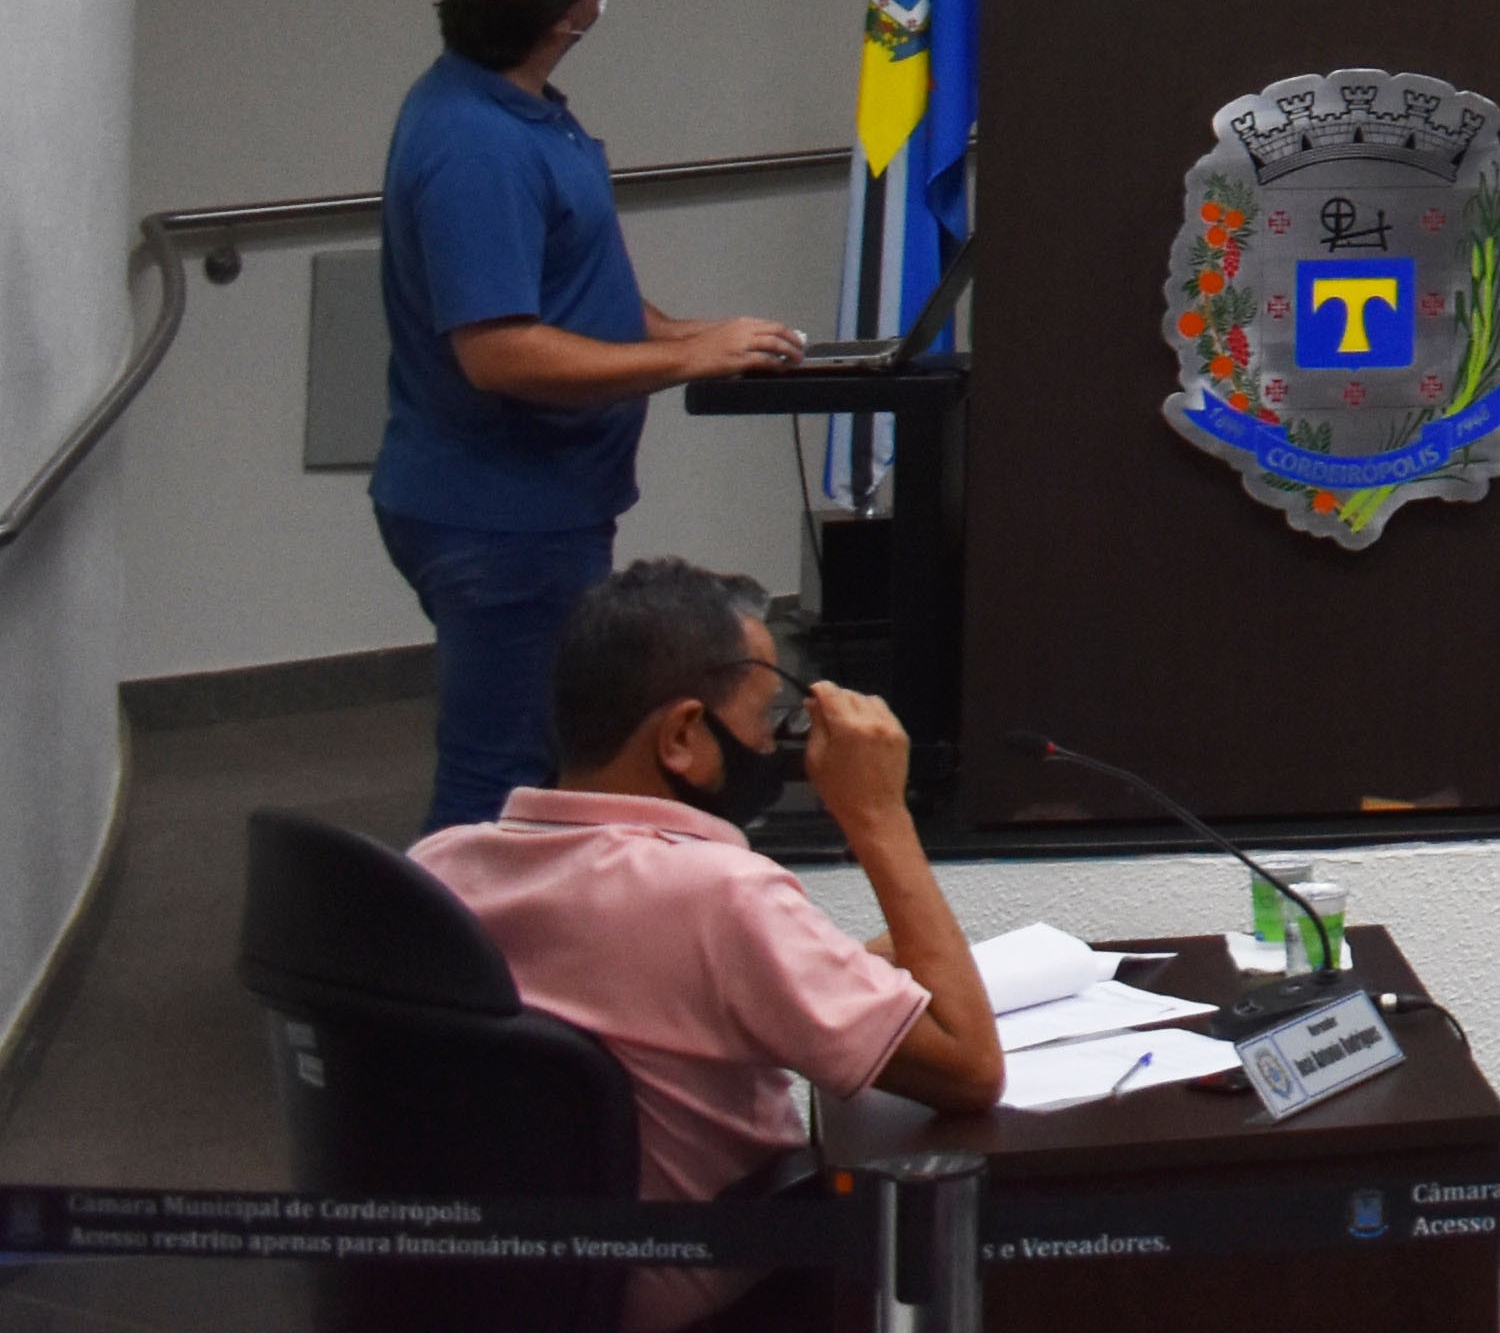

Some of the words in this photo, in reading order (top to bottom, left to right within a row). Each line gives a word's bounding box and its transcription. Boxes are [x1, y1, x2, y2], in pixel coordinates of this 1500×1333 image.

[1266, 444, 1440, 484] CORDEIRÓPOLIS
[163, 1196, 279, 1222] Municipal
[285, 1199, 314, 1219] de
[1412, 1214, 1495, 1236] Acesso
[153, 1230, 242, 1250] restrito
[249, 1233, 332, 1257] apenas
[337, 1235, 390, 1258] para
[398, 1234, 547, 1257] funcionários
[552, 1242, 566, 1256] e
[571, 1236, 714, 1260] Vereadores.
[1001, 1240, 1016, 1260] e
[1021, 1234, 1172, 1260] Vereadores.
